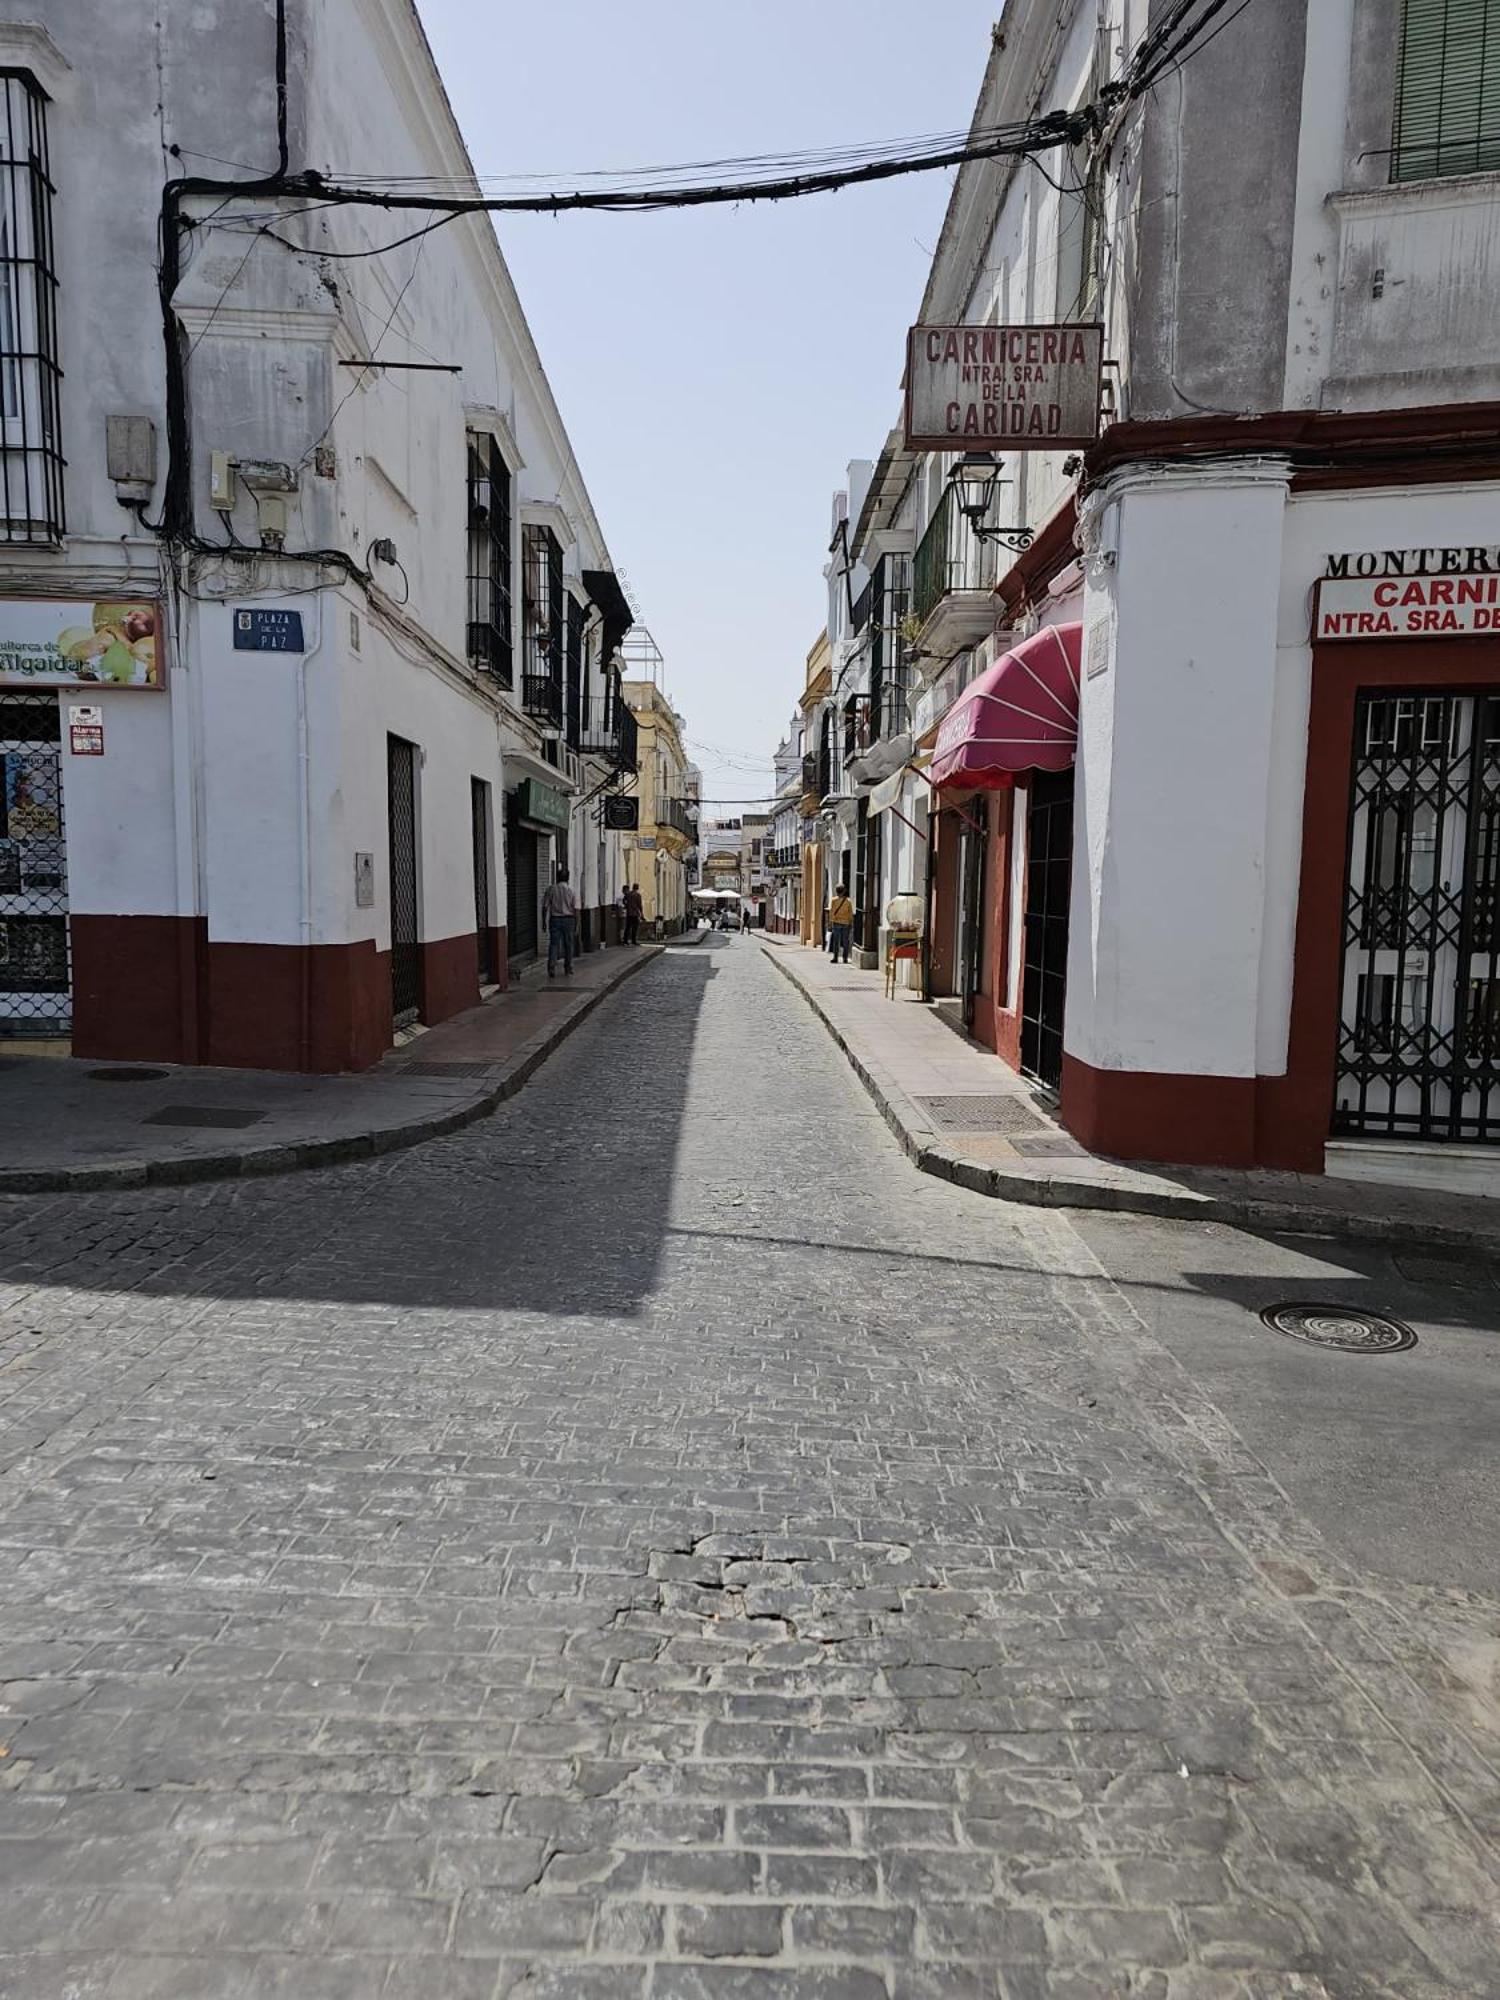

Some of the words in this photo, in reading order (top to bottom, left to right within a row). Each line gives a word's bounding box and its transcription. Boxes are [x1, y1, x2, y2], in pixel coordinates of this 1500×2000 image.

[926, 330, 1086, 364] CARNICERIA
[962, 365, 1007, 383] NTRA.
[1014, 365, 1049, 383] SRA.
[982, 384, 1000, 400] DE
[1007, 384, 1026, 401] LA
[946, 401, 1063, 435] CARIDAD
[1326, 547, 1500, 577] MONTER
[1374, 578, 1498, 607] CARNI
[257, 613, 289, 624] PLAZA
[1323, 611, 1398, 634] NTRA.
[1407, 609, 1465, 631] SRA.
[44, 642, 60, 652] de
[261, 635, 286, 648] PAZ
